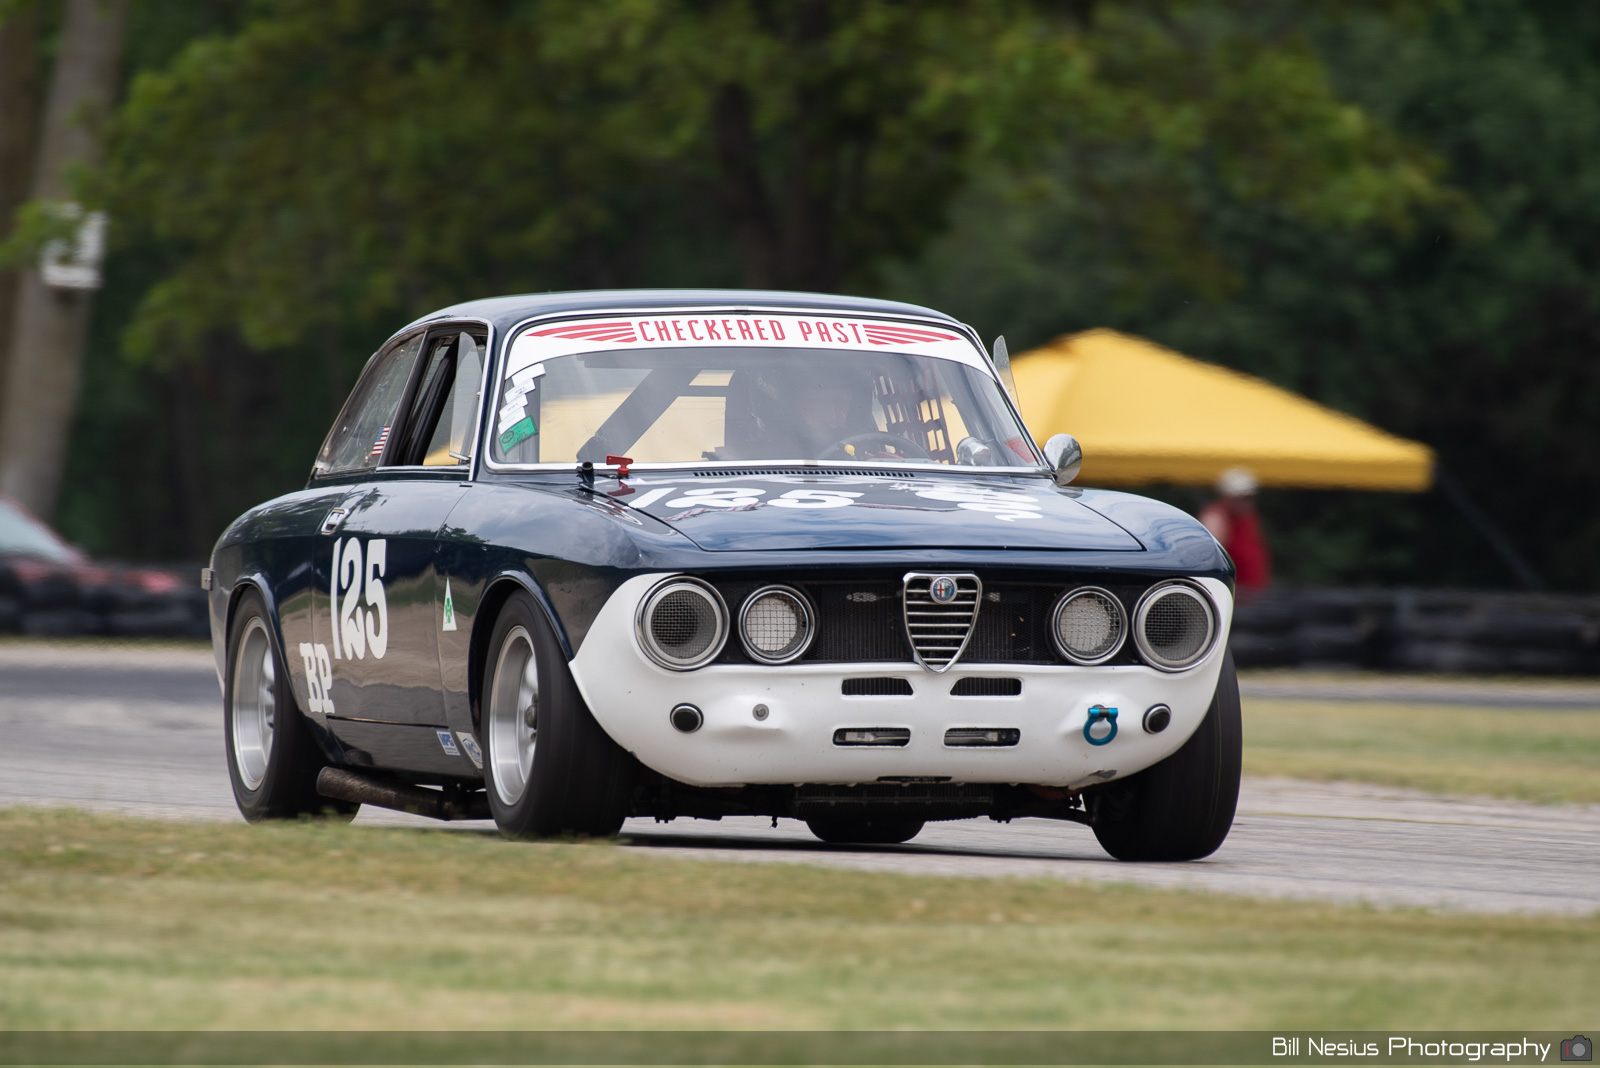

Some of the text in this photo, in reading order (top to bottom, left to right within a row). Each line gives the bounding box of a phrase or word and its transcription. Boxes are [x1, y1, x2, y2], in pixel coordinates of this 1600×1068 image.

[638, 320, 866, 344] CHECKERED PAST
[625, 487, 866, 509] 125
[331, 537, 389, 661] 125
[299, 641, 336, 714] BP
